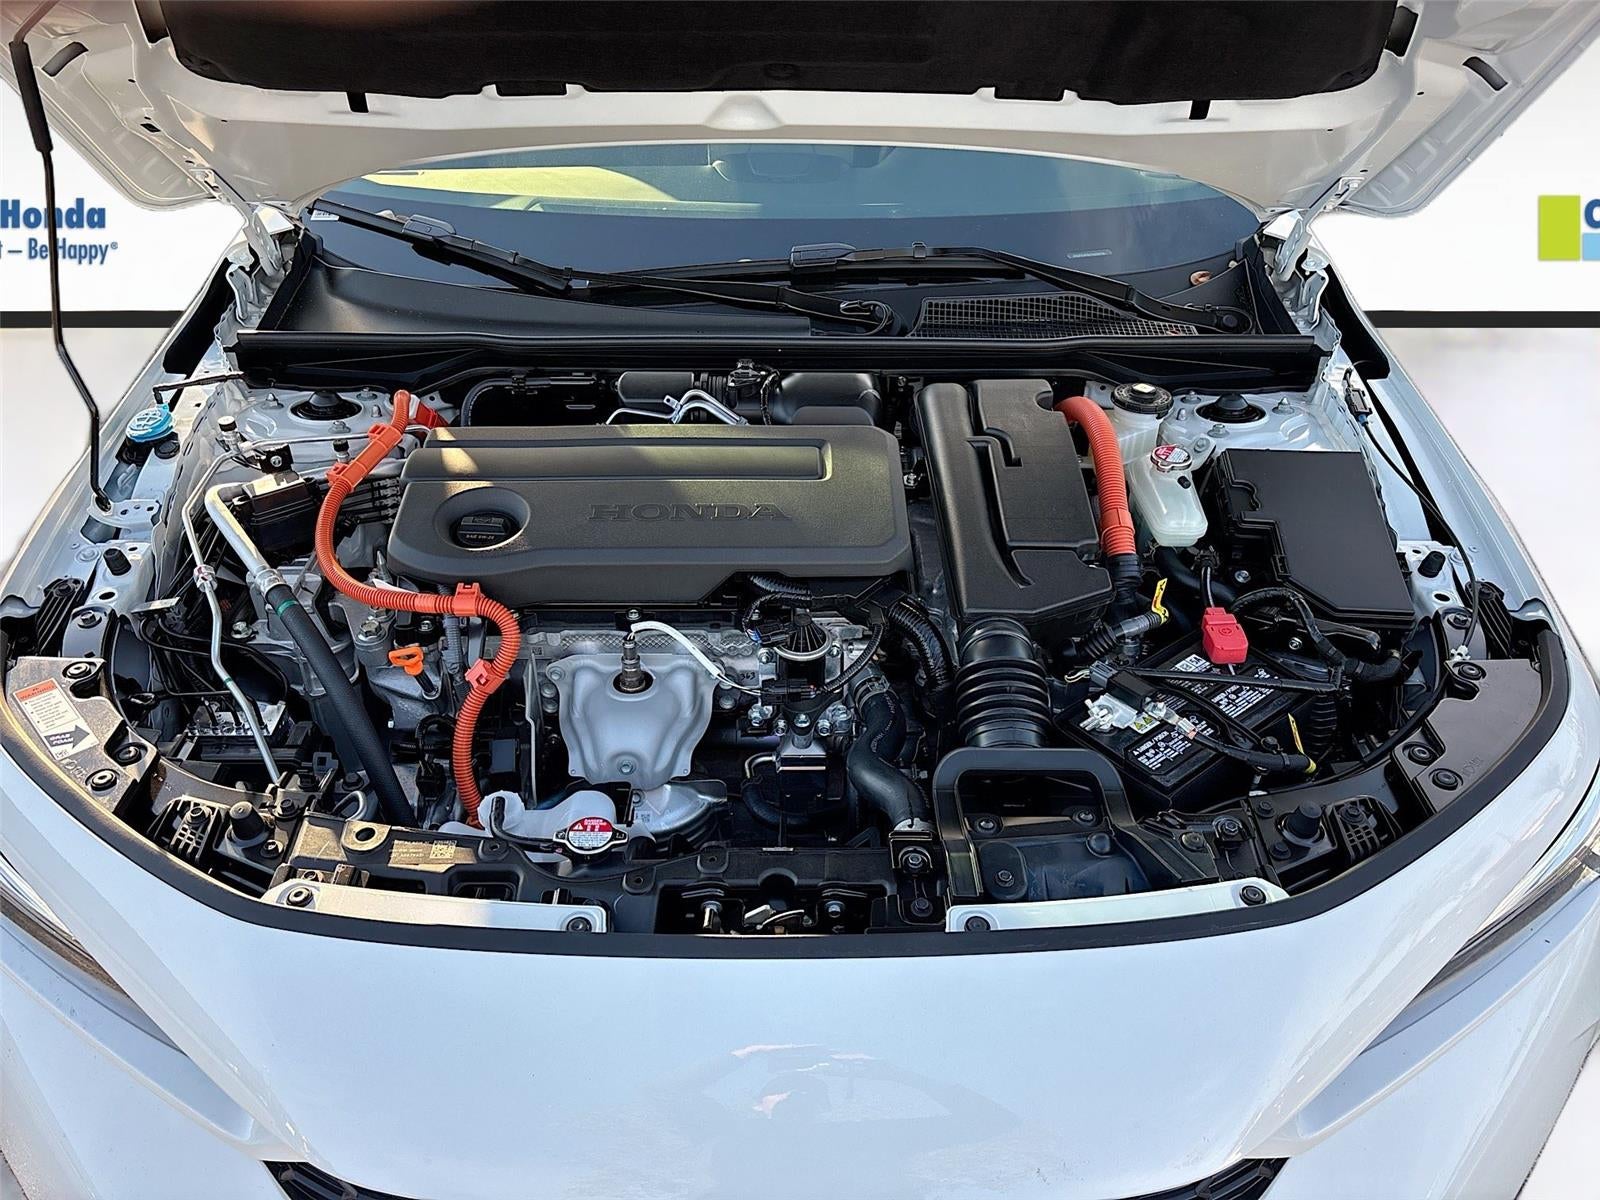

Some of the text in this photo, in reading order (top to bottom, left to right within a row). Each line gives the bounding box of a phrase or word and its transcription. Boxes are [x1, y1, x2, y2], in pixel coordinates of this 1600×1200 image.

[0, 198, 106, 229] Honda
[28, 238, 48, 260] Be
[586, 503, 792, 521] HONDA
